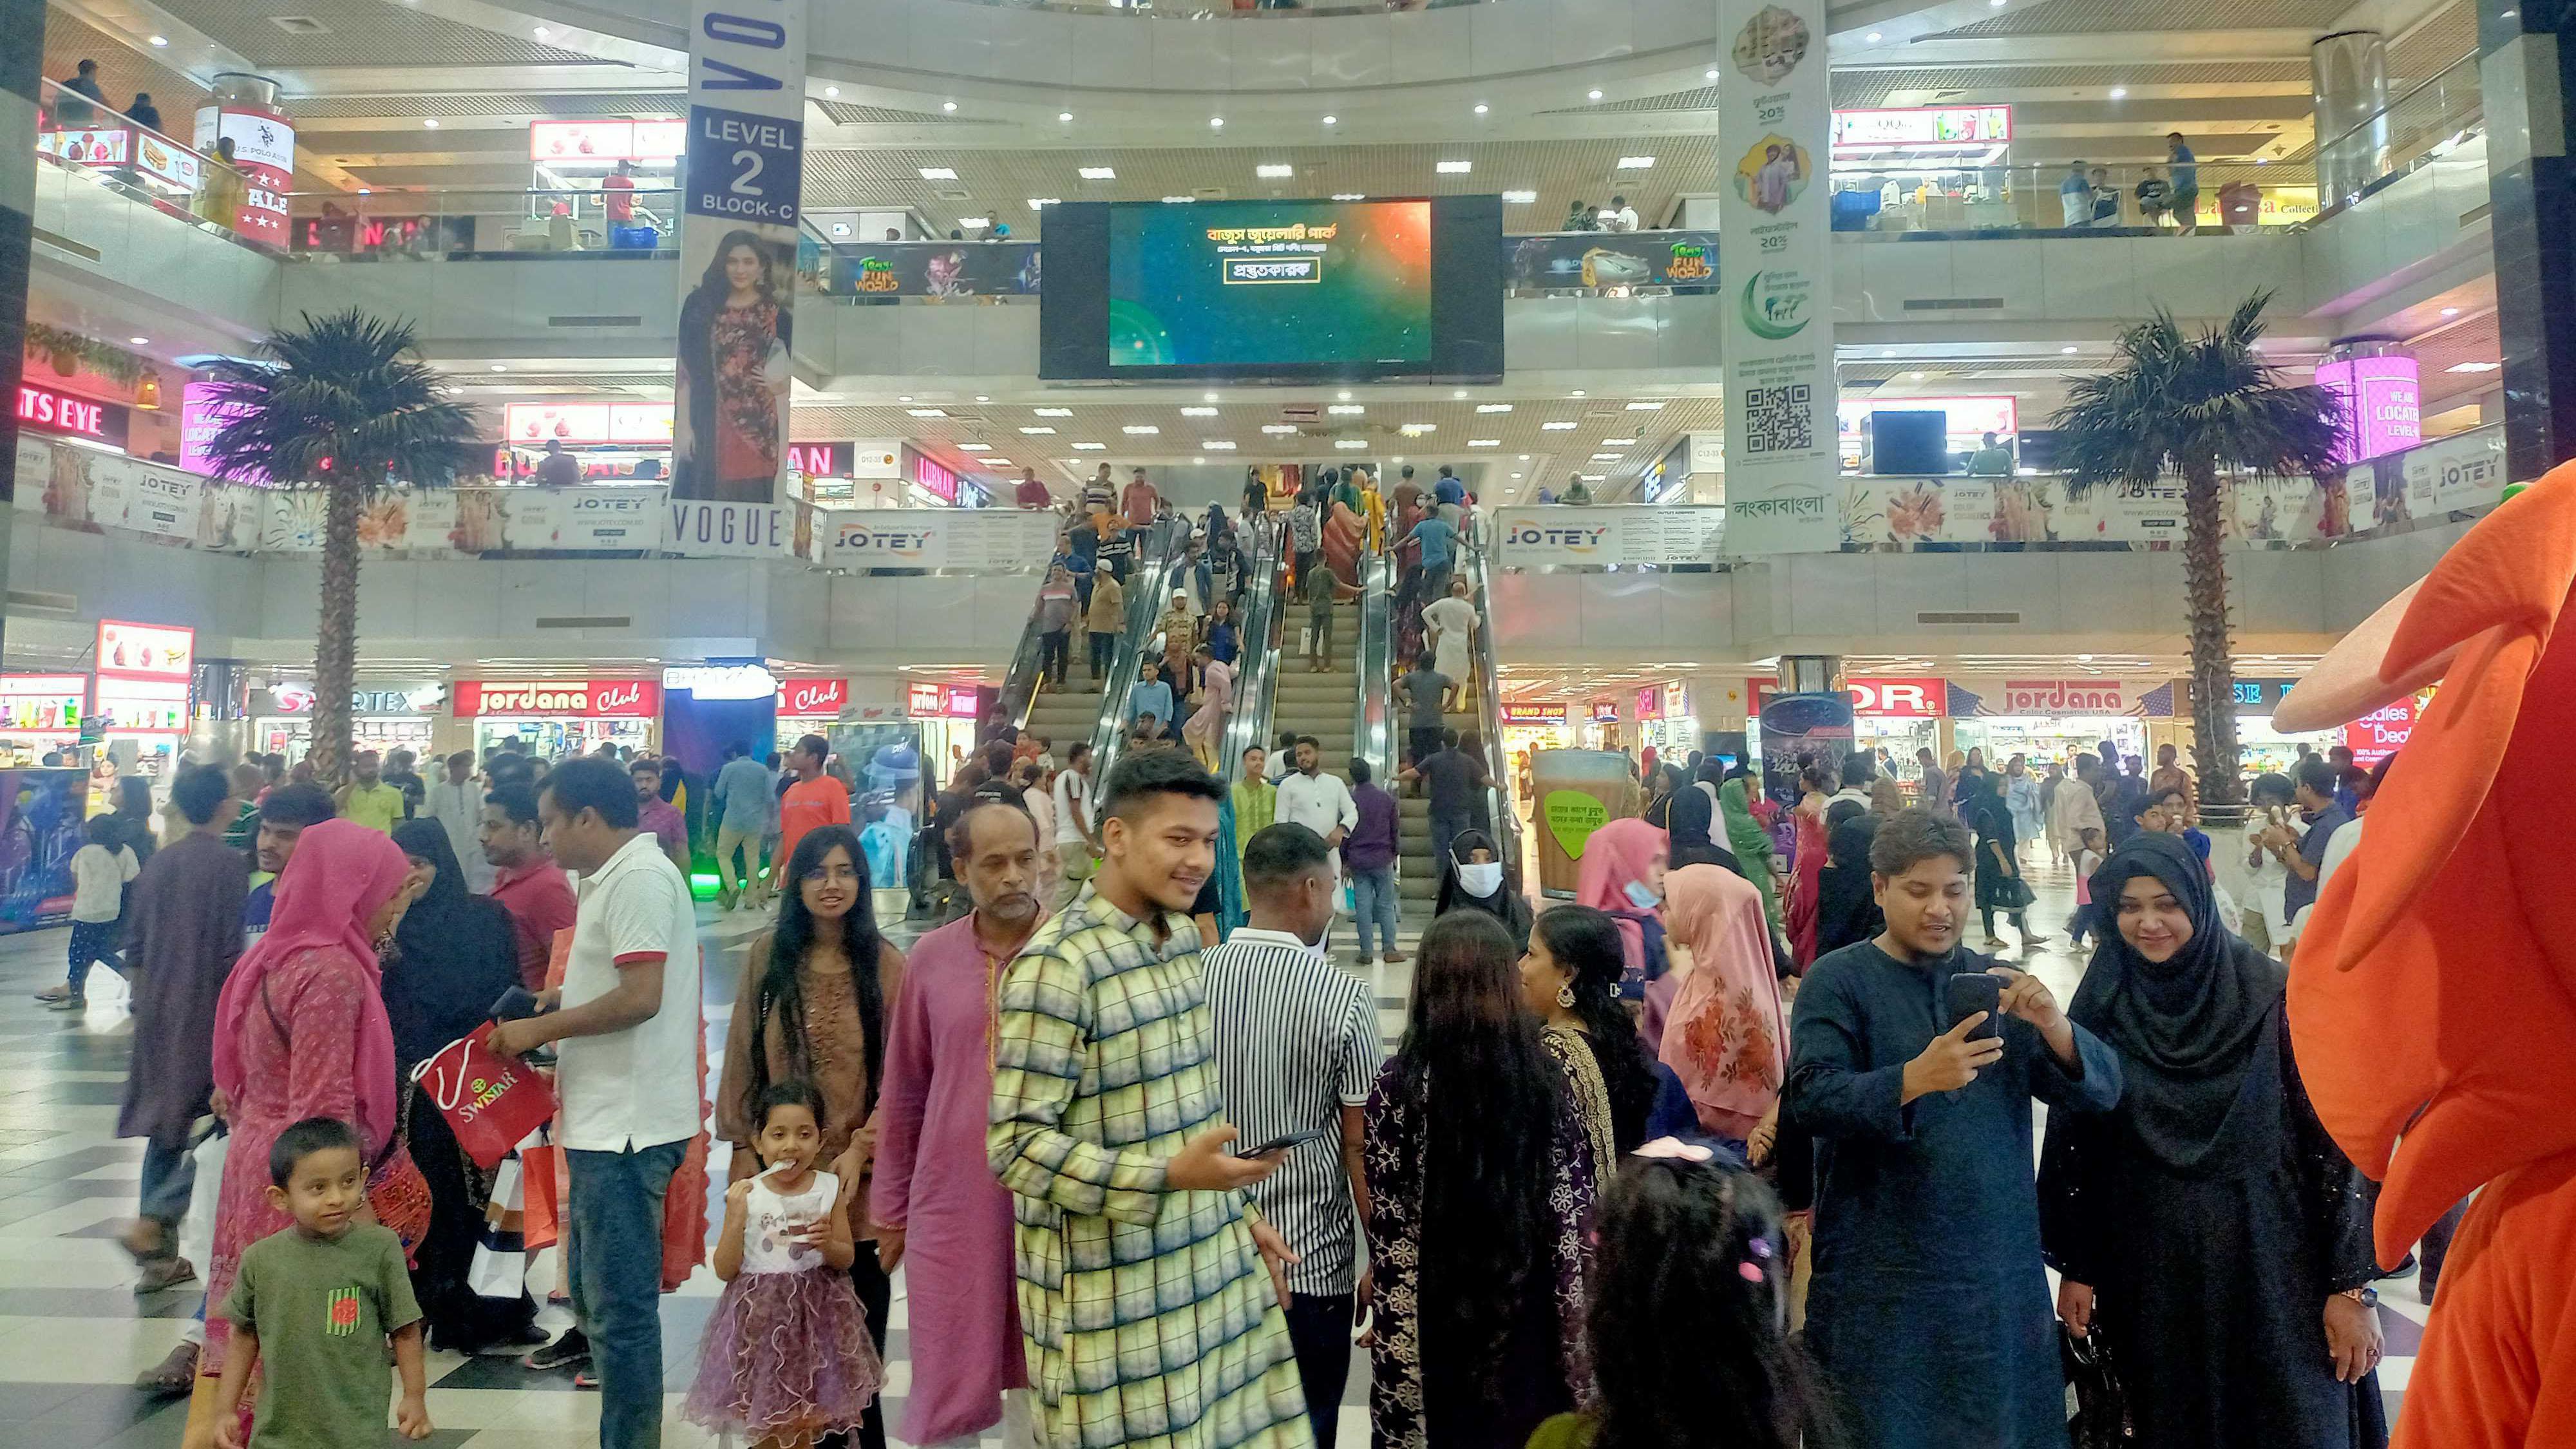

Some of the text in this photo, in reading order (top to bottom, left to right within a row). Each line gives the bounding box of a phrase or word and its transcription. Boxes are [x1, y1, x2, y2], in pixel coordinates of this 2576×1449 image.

[705, 117, 794, 150] LEVEL
[251, 147, 271, 157] POLO
[730, 149, 764, 196] 2
[249, 188, 288, 216] ALE
[2280, 205, 2319, 214] Collecti
[1207, 223, 1338, 244] বাজুস জুয়েলারি পার্ক
[1665, 267, 1712, 279] WORLD
[1674, 257, 1705, 268] FUN
[855, 280, 898, 292] WORLD
[862, 270, 893, 281] FUN
[2390, 391, 2403, 402] WE
[57, 398, 103, 435] EYE
[2439, 454, 2500, 488] JOTEY
[140, 474, 191, 496] JOTEY
[573, 497, 648, 509] JOTEY
[1732, 495, 1824, 518] লংকাবাংলা
[673, 504, 782, 547] VOGUE
[1507, 527, 1606, 545] JOTEY
[835, 531, 931, 548] JOTEY
[477, 681, 640, 715] jordana Club
[795, 680, 838, 710] Club
[1997, 681, 2122, 714] jordana
[1511, 706, 1565, 717] BRAND SHOP
[458, 1071, 518, 1123] SWISTAR
